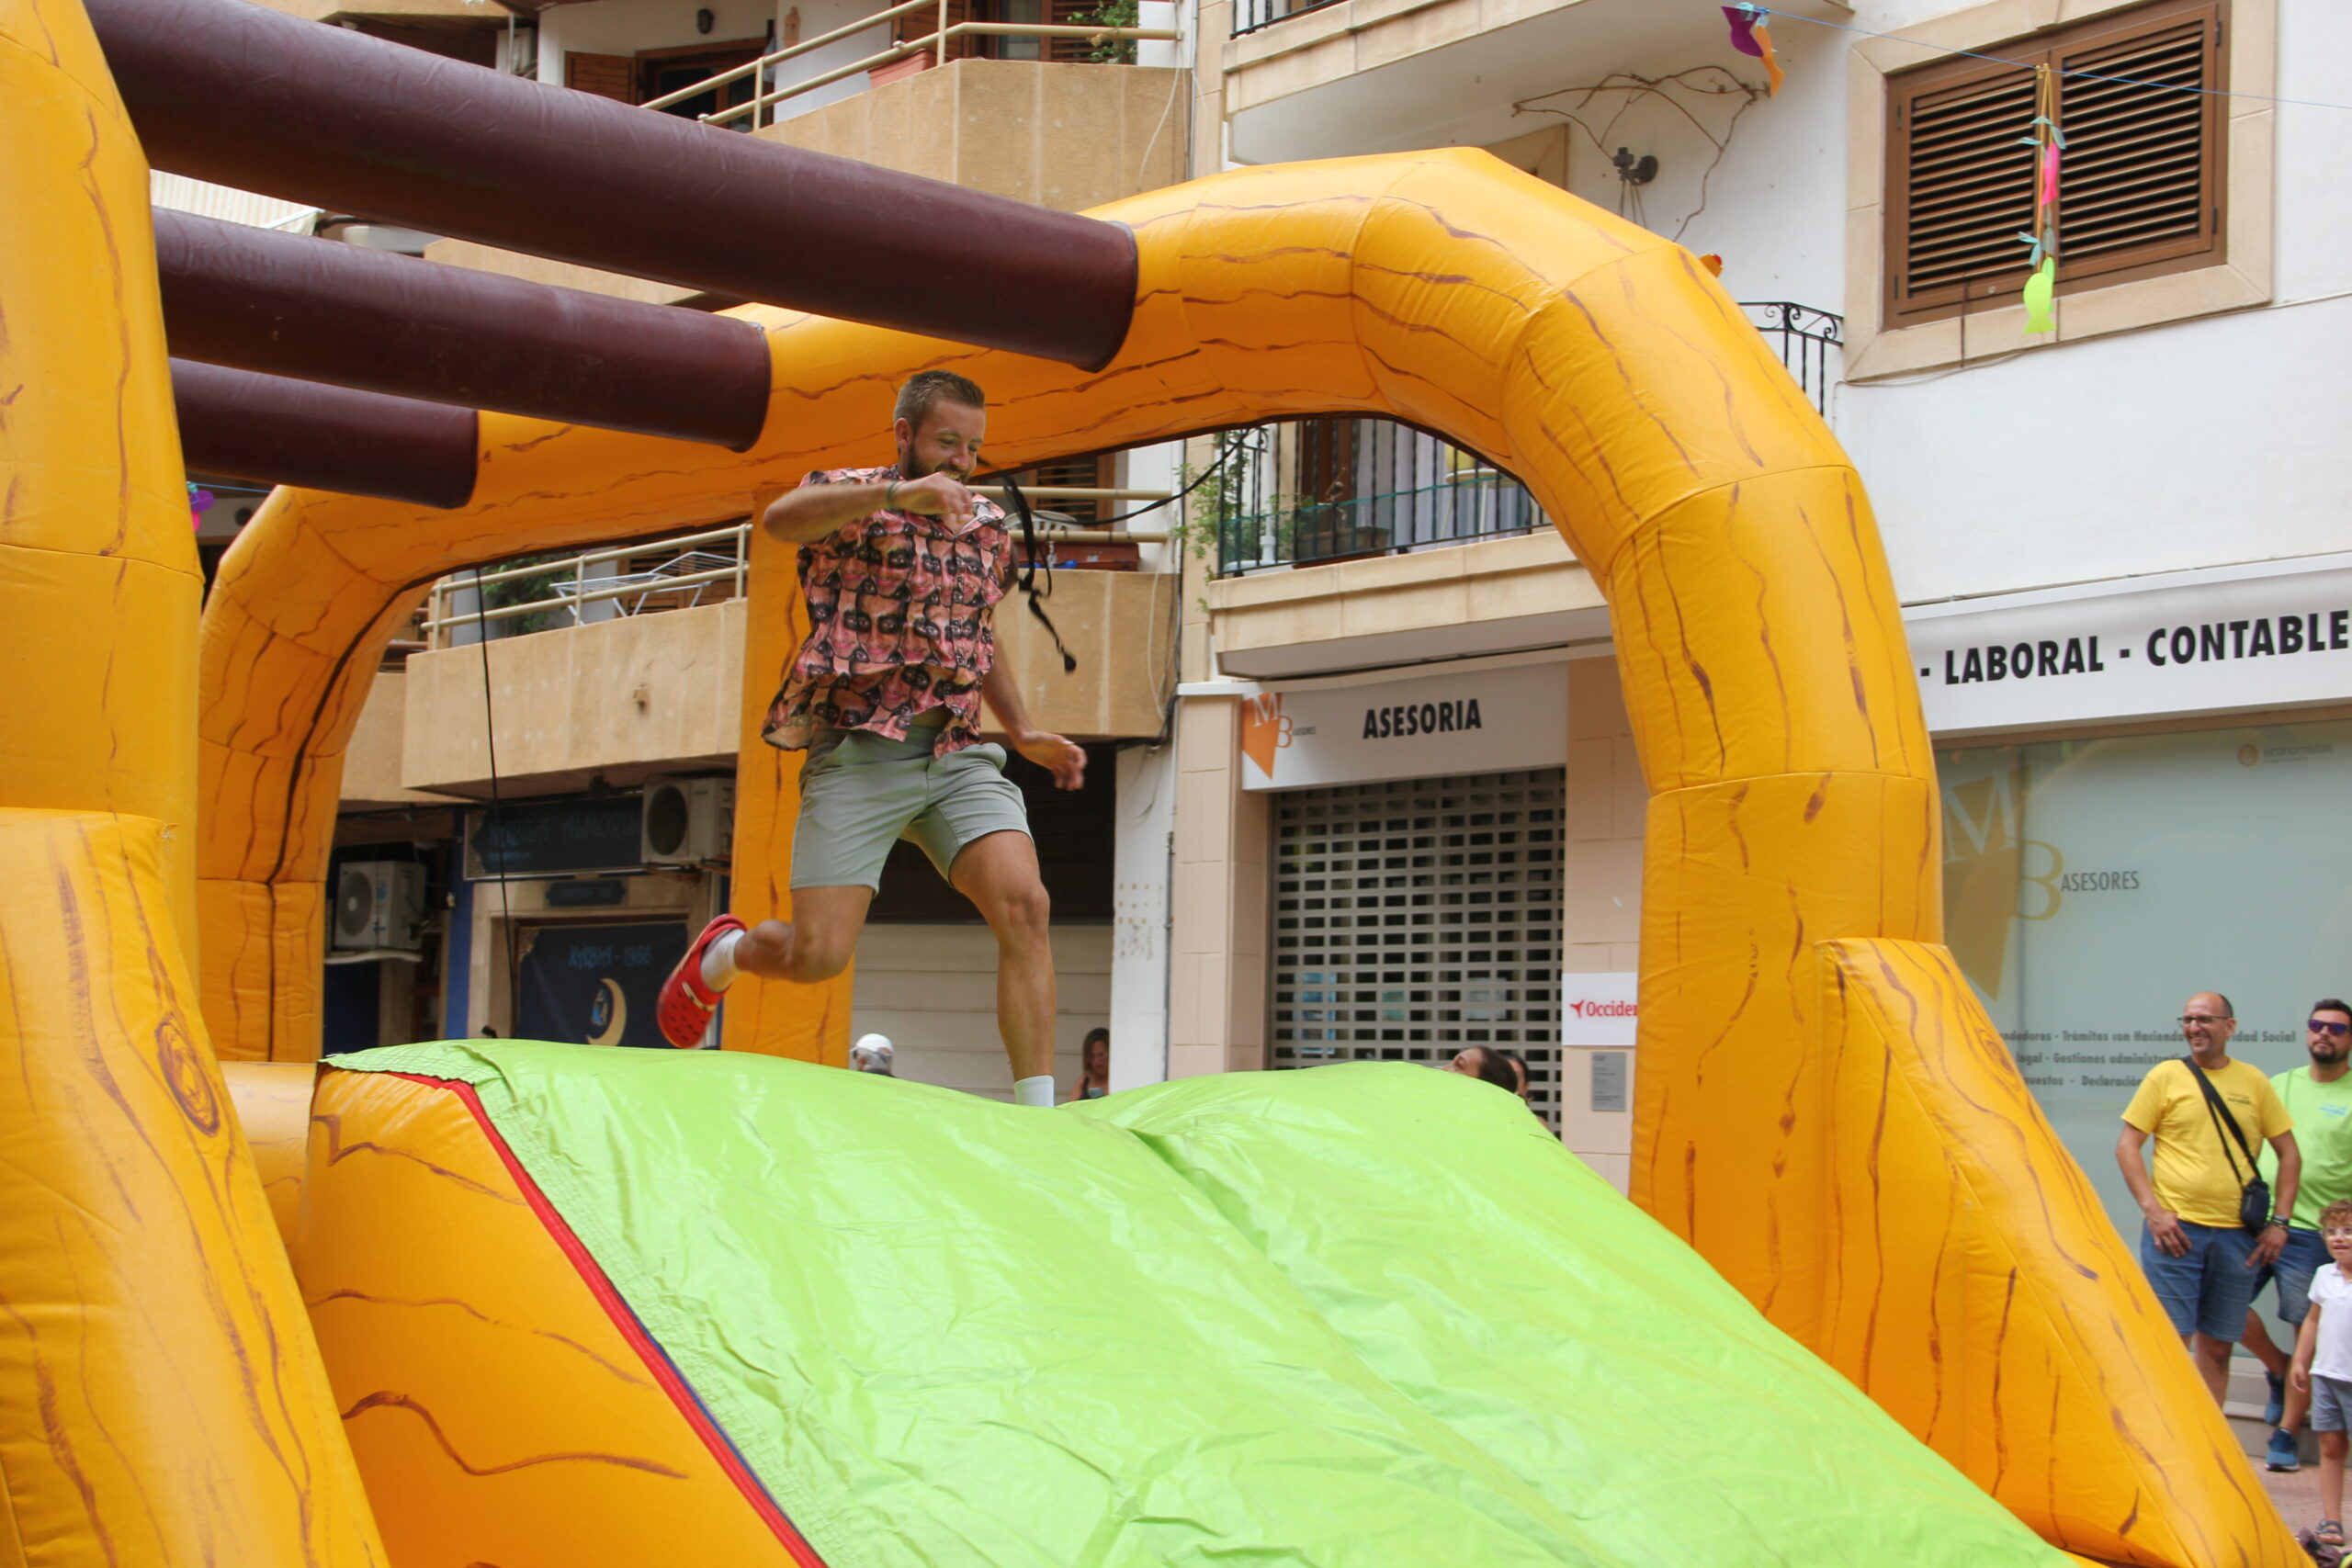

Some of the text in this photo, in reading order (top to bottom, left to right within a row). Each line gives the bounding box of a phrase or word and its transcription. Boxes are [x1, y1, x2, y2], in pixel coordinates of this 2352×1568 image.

[1944, 635, 2104, 685] LABORAL
[2146, 609, 2349, 667] CONTABLE
[1362, 698, 1483, 739] ASESORIA
[2060, 870, 2141, 893] ASESORES
[2063, 1030, 2109, 1042] Trámites
[2111, 1032, 2131, 1042] con
[2133, 1029, 2185, 1043] Hacienda
[2261, 1030, 2296, 1042] Social
[2052, 1052, 2107, 1065] Gestiones
